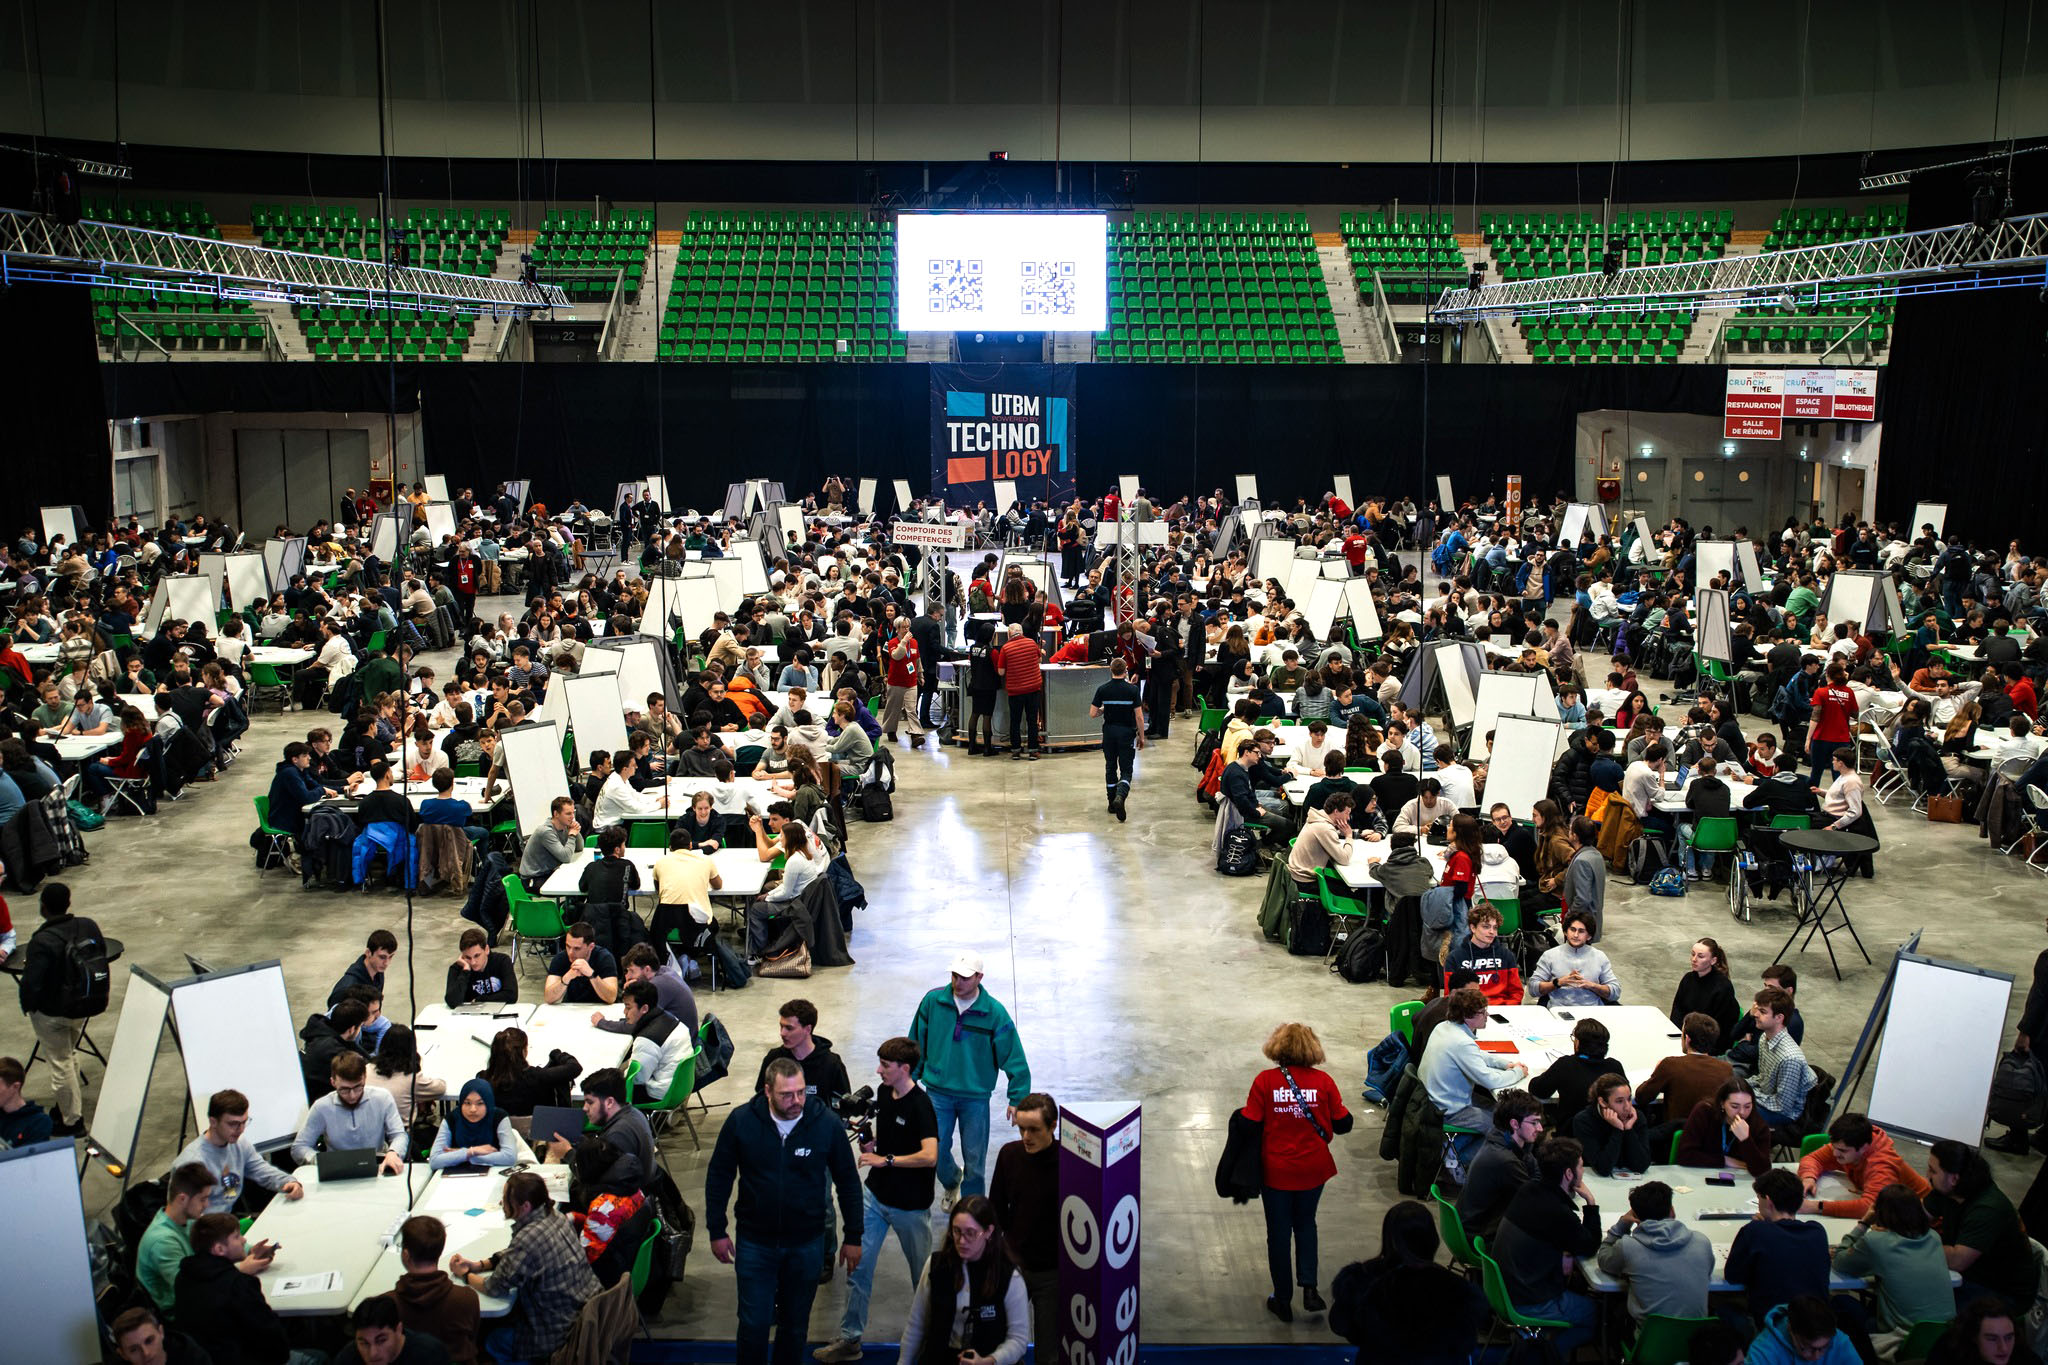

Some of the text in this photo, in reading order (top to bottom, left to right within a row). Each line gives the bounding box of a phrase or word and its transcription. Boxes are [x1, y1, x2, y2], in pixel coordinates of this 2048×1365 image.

[563, 332, 575, 340] 22
[1408, 333, 1419, 343] 23
[1429, 334, 1440, 343] 23
[1806, 386, 1824, 394] TIME
[992, 393, 1040, 416] UTBM
[1727, 401, 1781, 409] RESTAURATION
[1834, 404, 1873, 412] BIBLIOTHEQUE
[992, 415, 1029, 423] POWERED
[1742, 427, 1774, 435] RÉUNION
[946, 422, 1040, 453] TECHNO
[992, 449, 1053, 479] LOGY
[895, 525, 953, 536] COMPTOIR DES
[895, 534, 952, 544] COMPETENCES
[1461, 958, 1502, 969] SUPER
[1273, 1086, 1317, 1102] RÉFEENT
